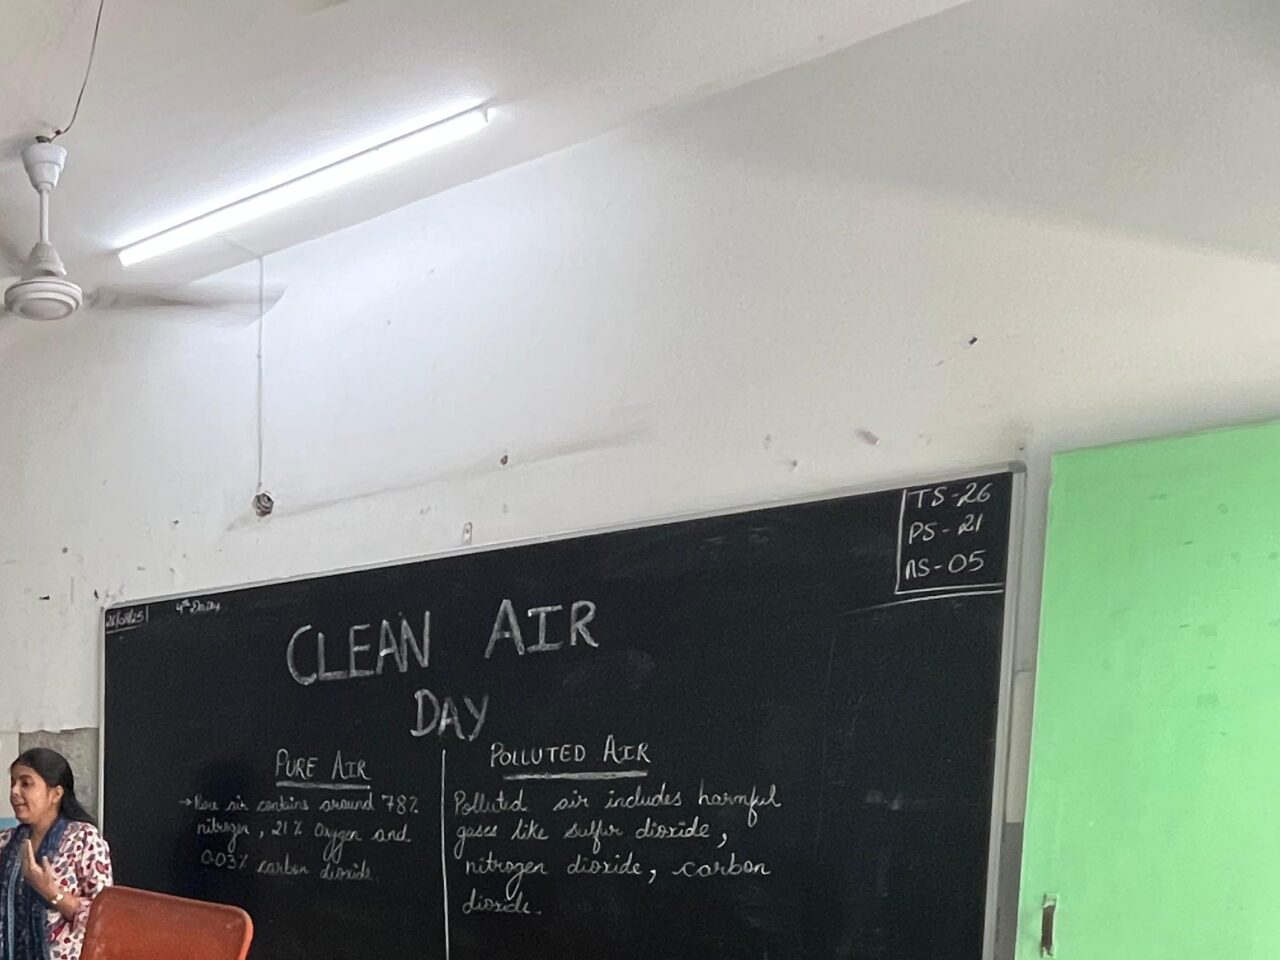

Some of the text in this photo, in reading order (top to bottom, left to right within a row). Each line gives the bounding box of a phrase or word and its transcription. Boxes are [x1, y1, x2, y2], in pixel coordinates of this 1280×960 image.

[287, 599, 598, 685] CLEAN AIR
[410, 688, 489, 741] DAY
[275, 749, 371, 780] PURE AIR
[490, 734, 651, 767] POLLUTED AIR
[225, 795, 249, 811] air
[256, 796, 309, 812] contains
[319, 792, 375, 812] around
[381, 794, 418, 815] 78%
[454, 779, 782, 827] Polluted air includes harmful
[370, 823, 411, 842] and
[456, 825, 498, 859] gases
[511, 821, 549, 840] like
[564, 820, 623, 854] sulfur
[257, 853, 309, 875] carbon
[466, 851, 549, 900] nitrogen
[672, 852, 771, 876] carbon
